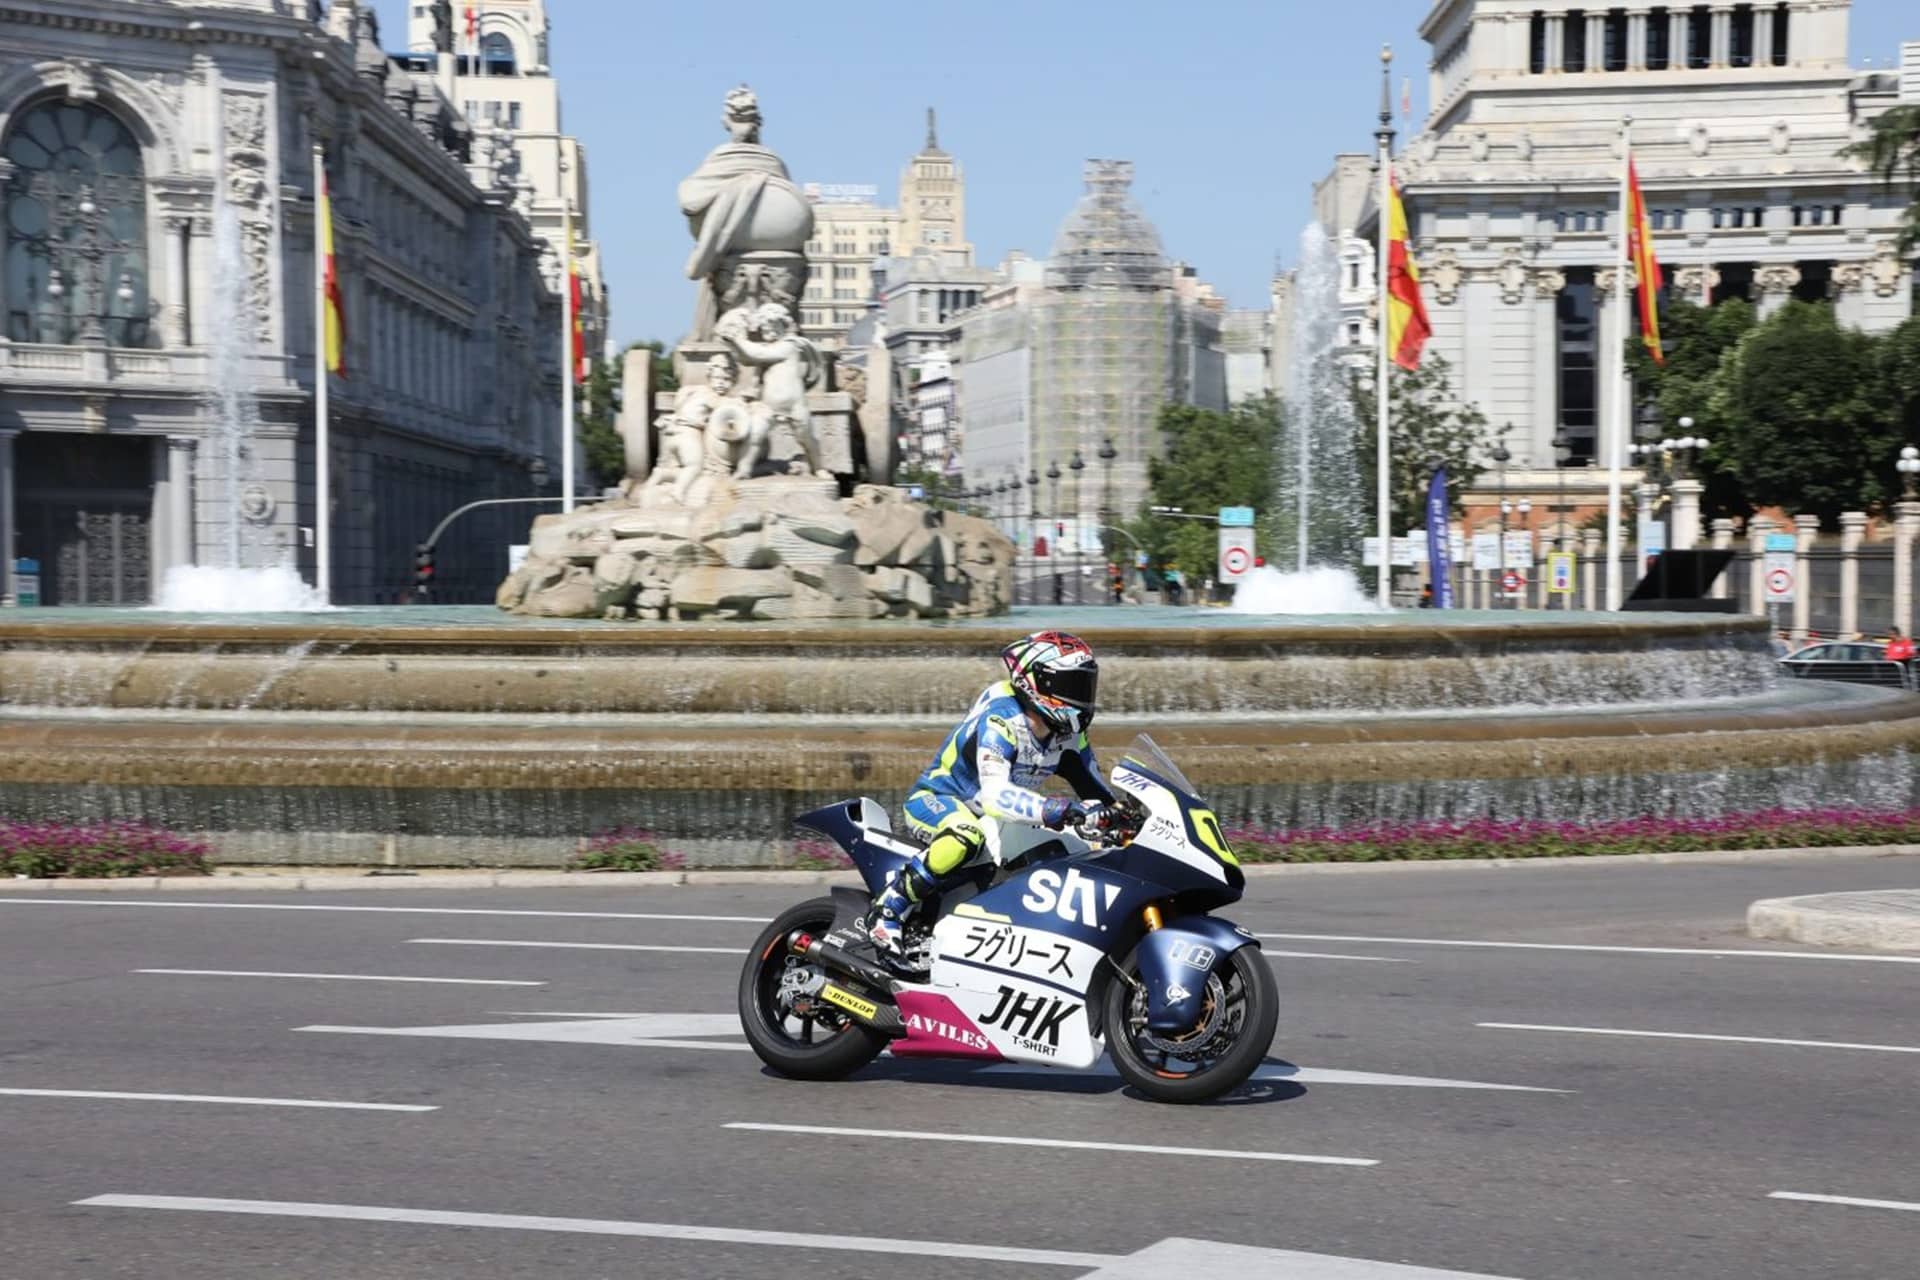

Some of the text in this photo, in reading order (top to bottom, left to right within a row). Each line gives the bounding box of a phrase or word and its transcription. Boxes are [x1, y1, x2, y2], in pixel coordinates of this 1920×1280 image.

[1113, 772, 1155, 790] JHK
[1149, 823, 1187, 849] ラグリース
[964, 925, 1074, 979] ラグリース
[832, 992, 874, 1014] DUNLOP
[977, 985, 1084, 1046] JHK
[907, 1013, 989, 1051] AVILES
[1012, 1035, 1058, 1057] T-SHIRT
